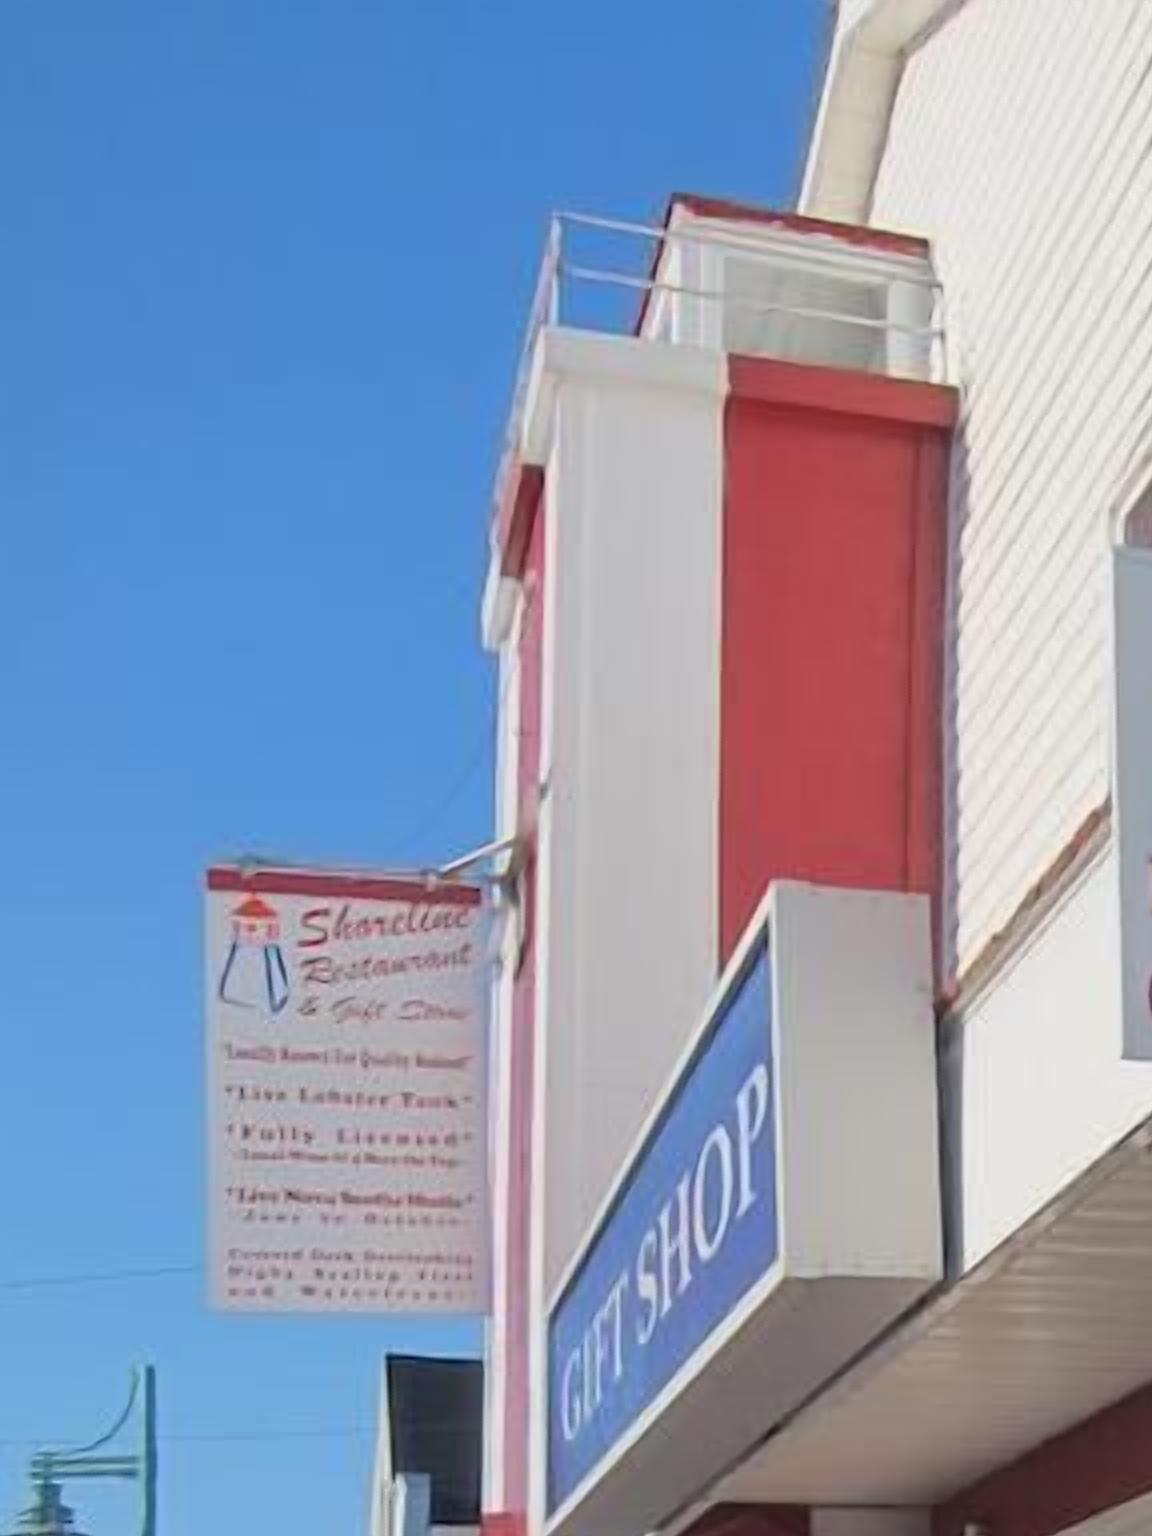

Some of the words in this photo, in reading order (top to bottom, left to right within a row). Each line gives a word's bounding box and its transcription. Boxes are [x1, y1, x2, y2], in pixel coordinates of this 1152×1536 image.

[298, 903, 470, 947] Shoreline
[298, 943, 472, 983] Restaurant
[561, 1273, 629, 1441] GIFT
[636, 1064, 769, 1346] SHOP
